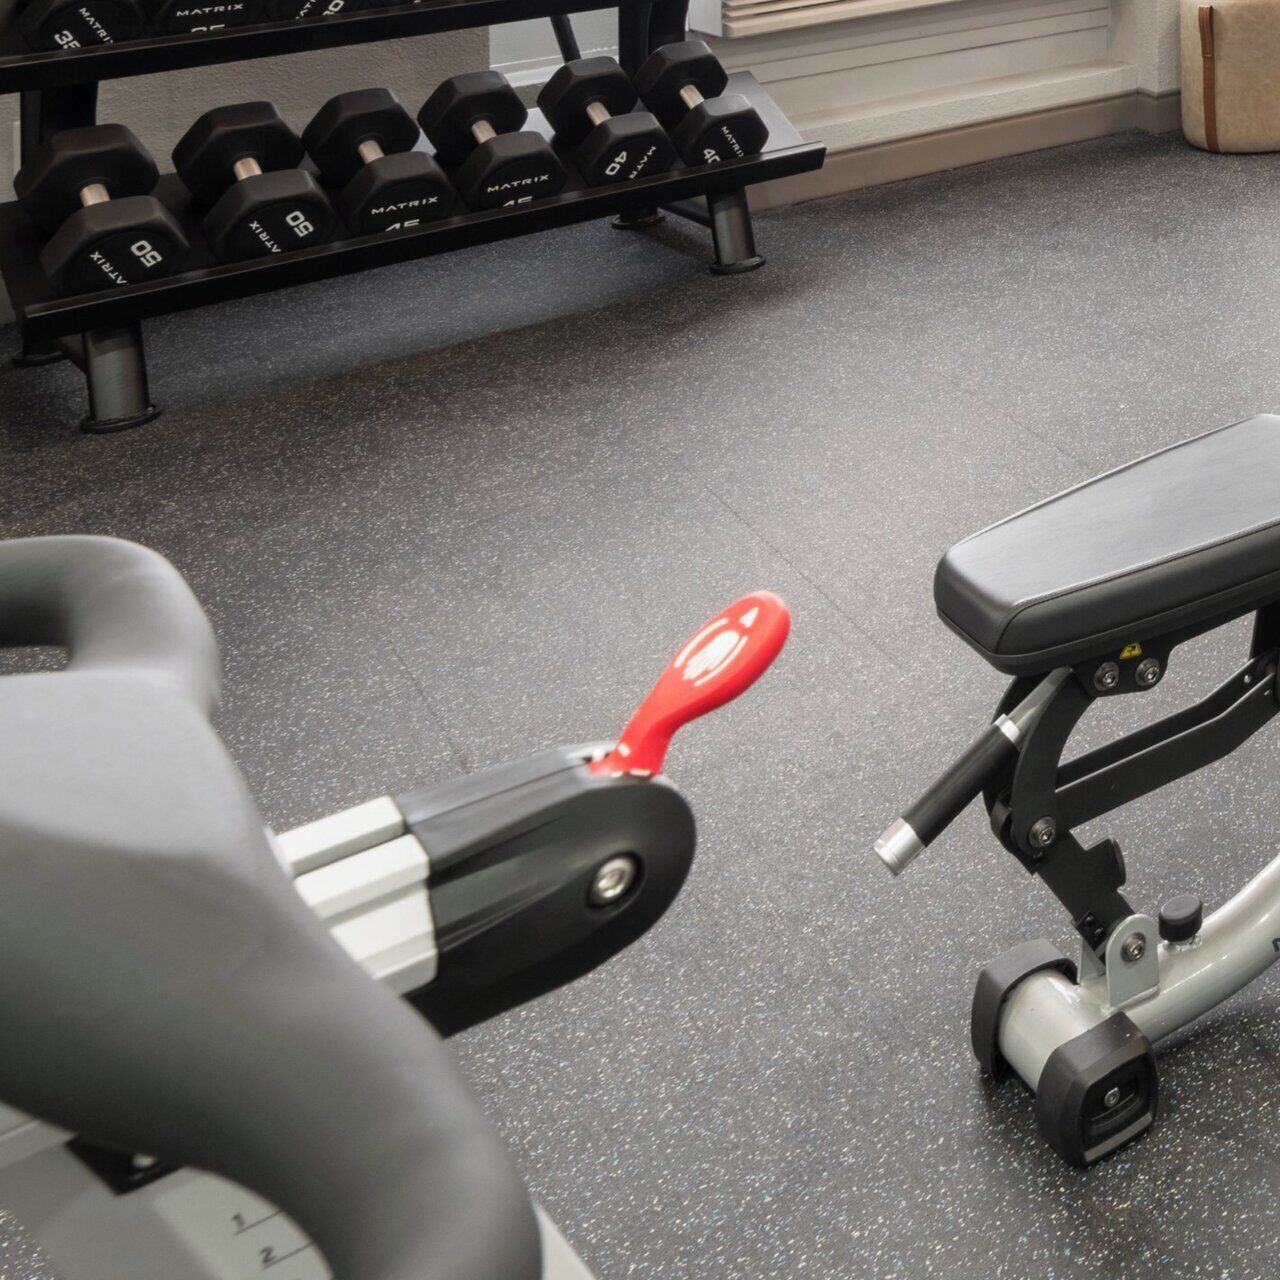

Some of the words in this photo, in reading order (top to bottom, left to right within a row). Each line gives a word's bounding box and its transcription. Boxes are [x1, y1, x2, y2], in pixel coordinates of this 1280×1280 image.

[176, 3, 244, 17] MATRIX
[605, 150, 627, 176] 40
[487, 174, 549, 193] MATRIX
[371, 196, 439, 215] MATRIX
[285, 210, 314, 238] 50
[130, 239, 163, 268] 50
[230, 1211, 246, 1230] 1
[258, 1245, 277, 1265] 2
